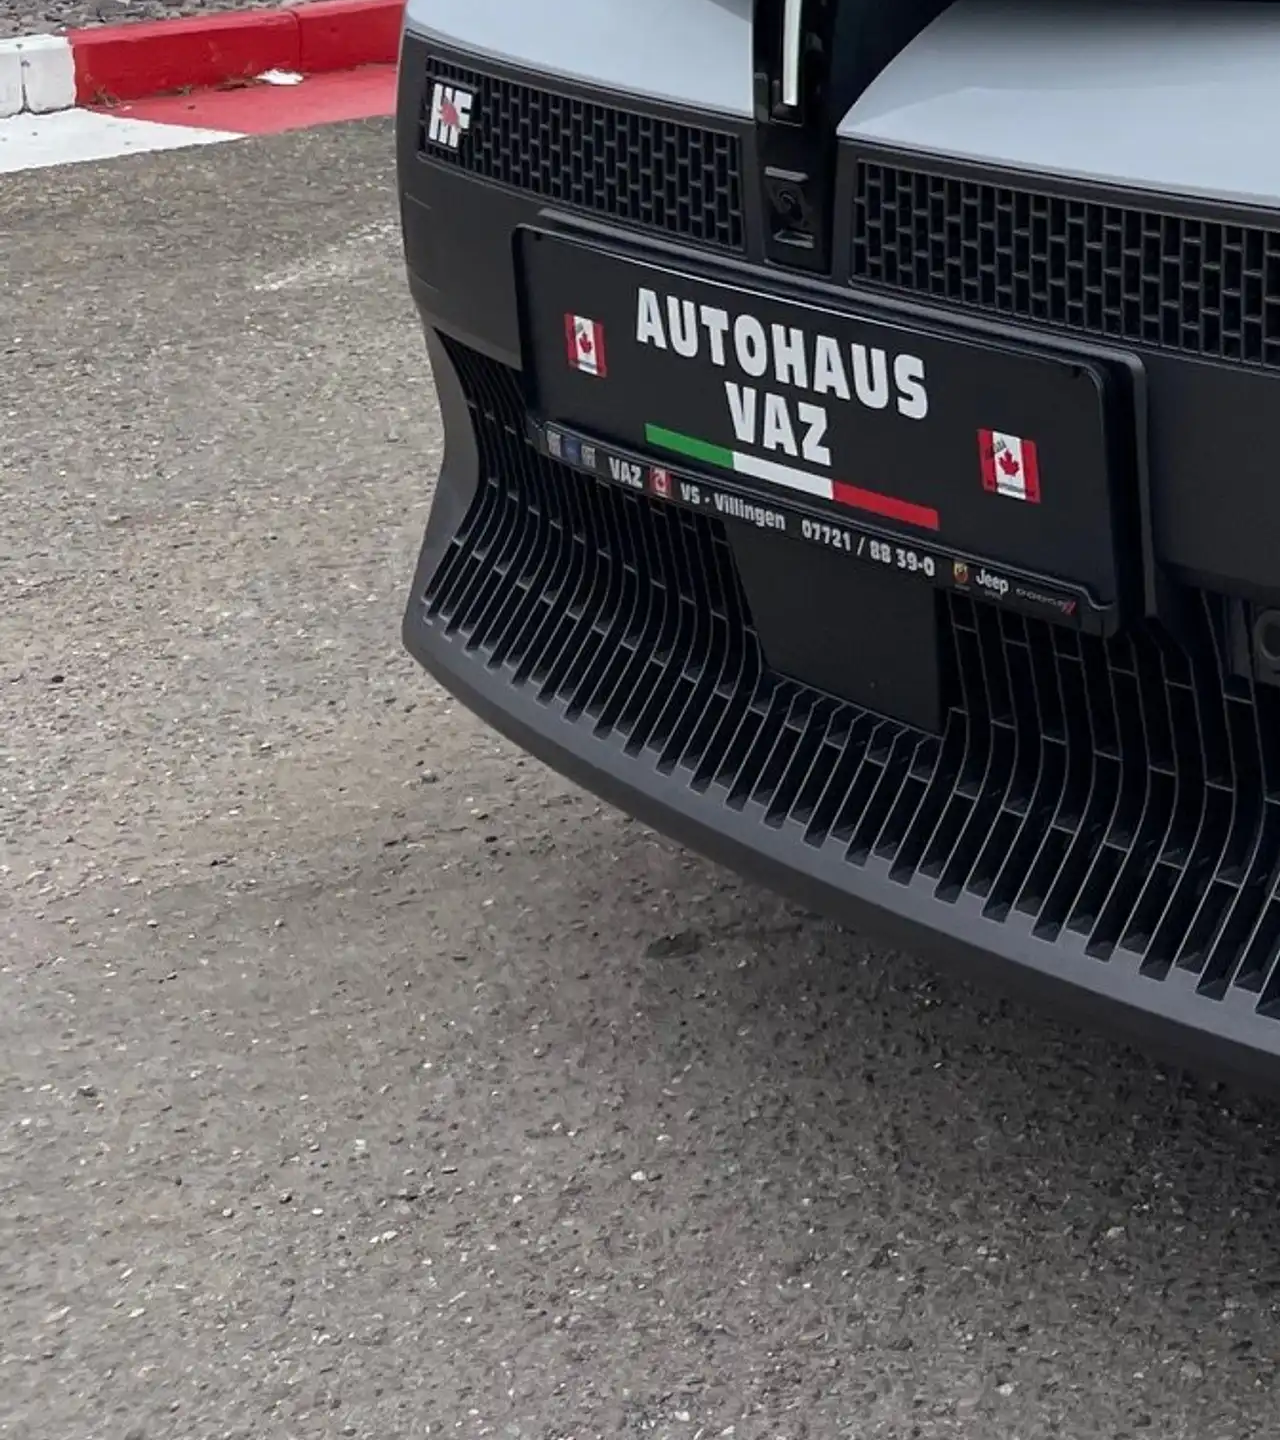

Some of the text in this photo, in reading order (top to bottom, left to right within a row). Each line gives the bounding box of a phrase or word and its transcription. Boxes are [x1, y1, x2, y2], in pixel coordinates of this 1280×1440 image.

[636, 287, 929, 420] AUTOHAUS
[724, 381, 832, 466] VAZ
[608, 456, 644, 489] VAZ
[680, 482, 701, 504] VS
[714, 492, 786, 531] Villingen
[802, 519, 851, 551] 07721
[856, 536, 866, 556] /
[870, 540, 892, 563] 88
[896, 548, 936, 577] 39-0
[975, 569, 1009, 596] Jeep
